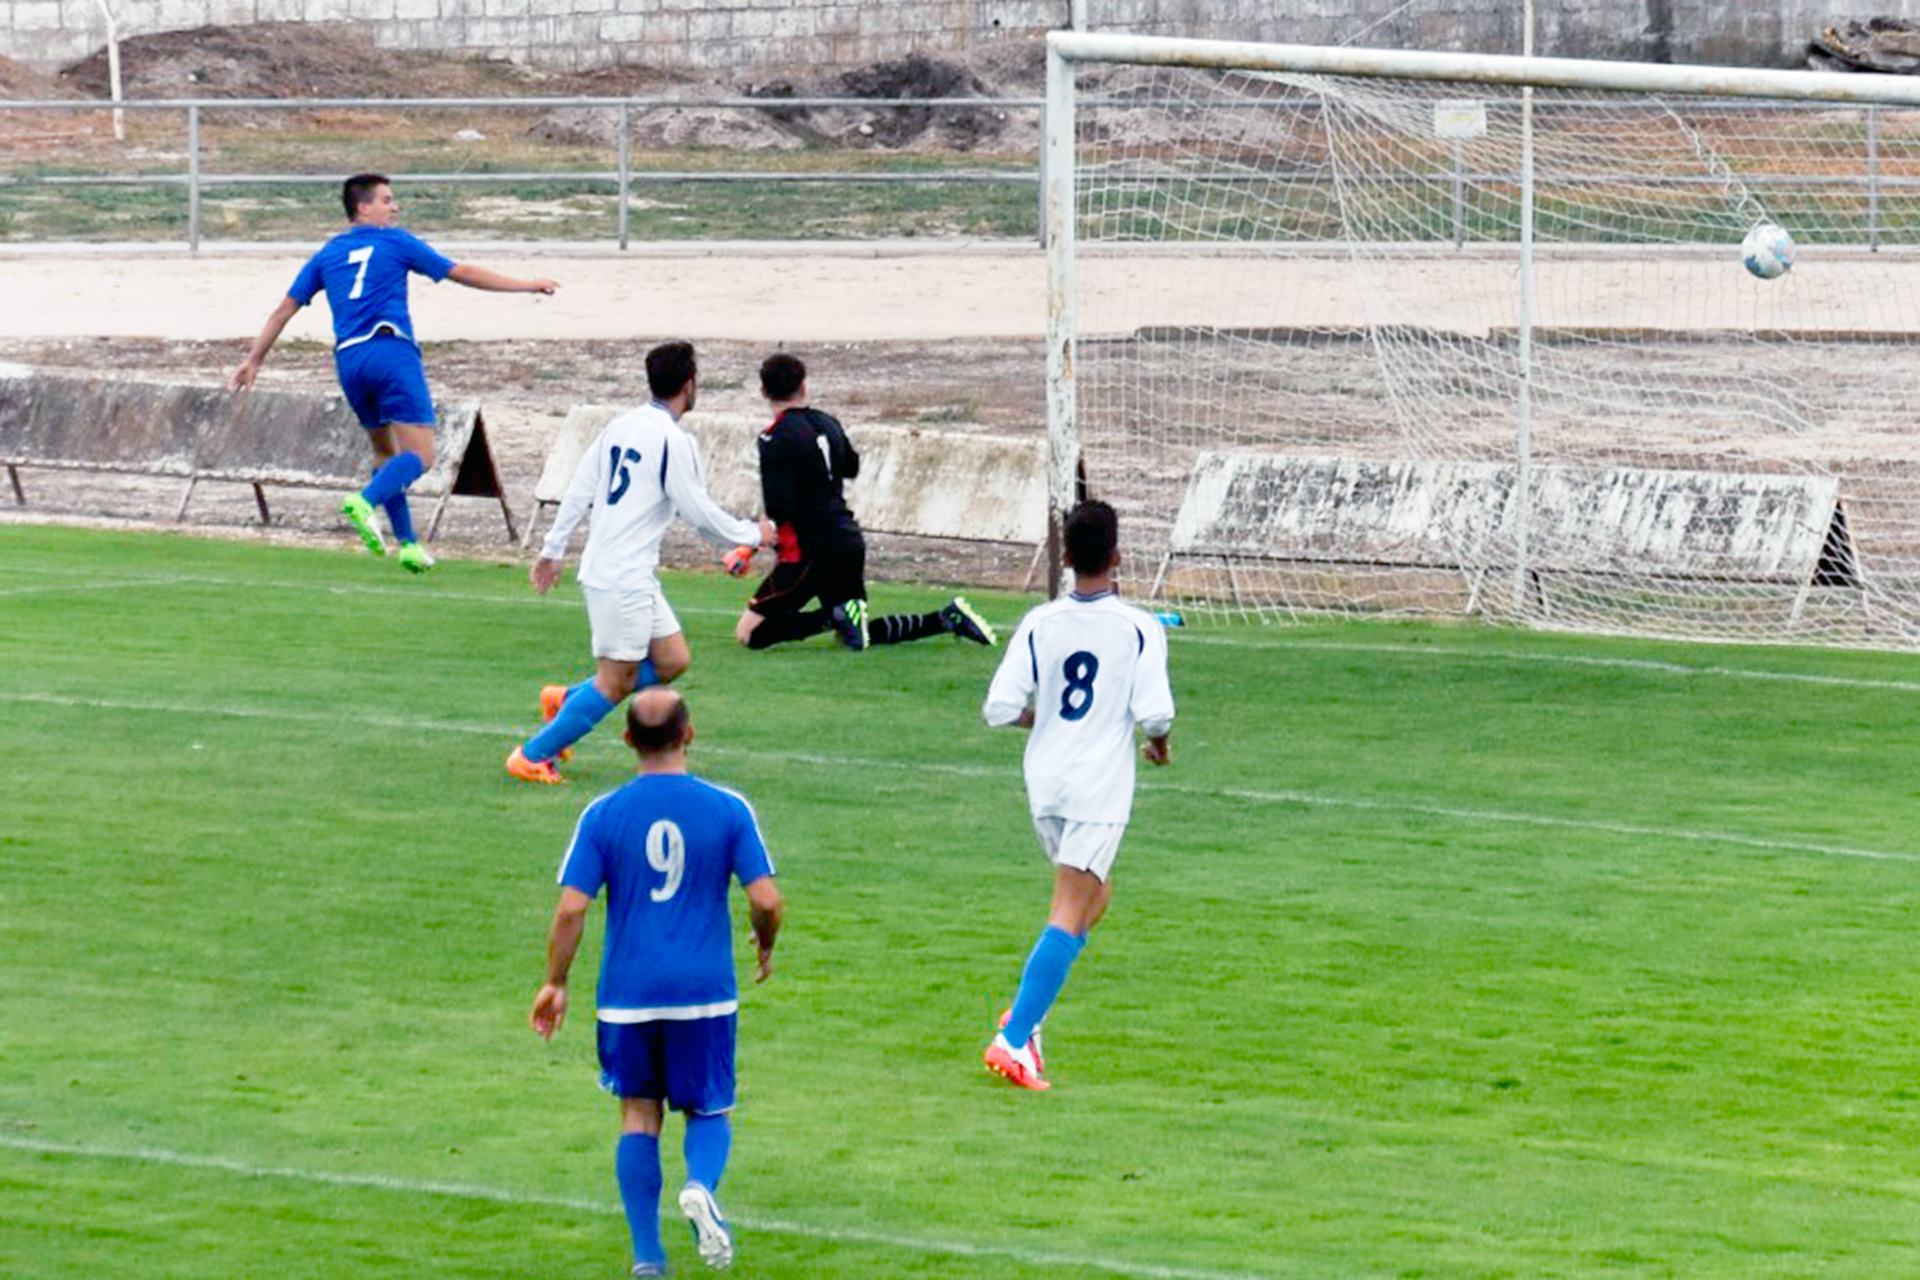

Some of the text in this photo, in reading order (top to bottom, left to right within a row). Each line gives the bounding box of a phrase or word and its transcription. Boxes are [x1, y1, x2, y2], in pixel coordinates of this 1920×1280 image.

[348, 245, 374, 300] 7
[1059, 650, 1099, 721] 8
[645, 819, 685, 903] 9
